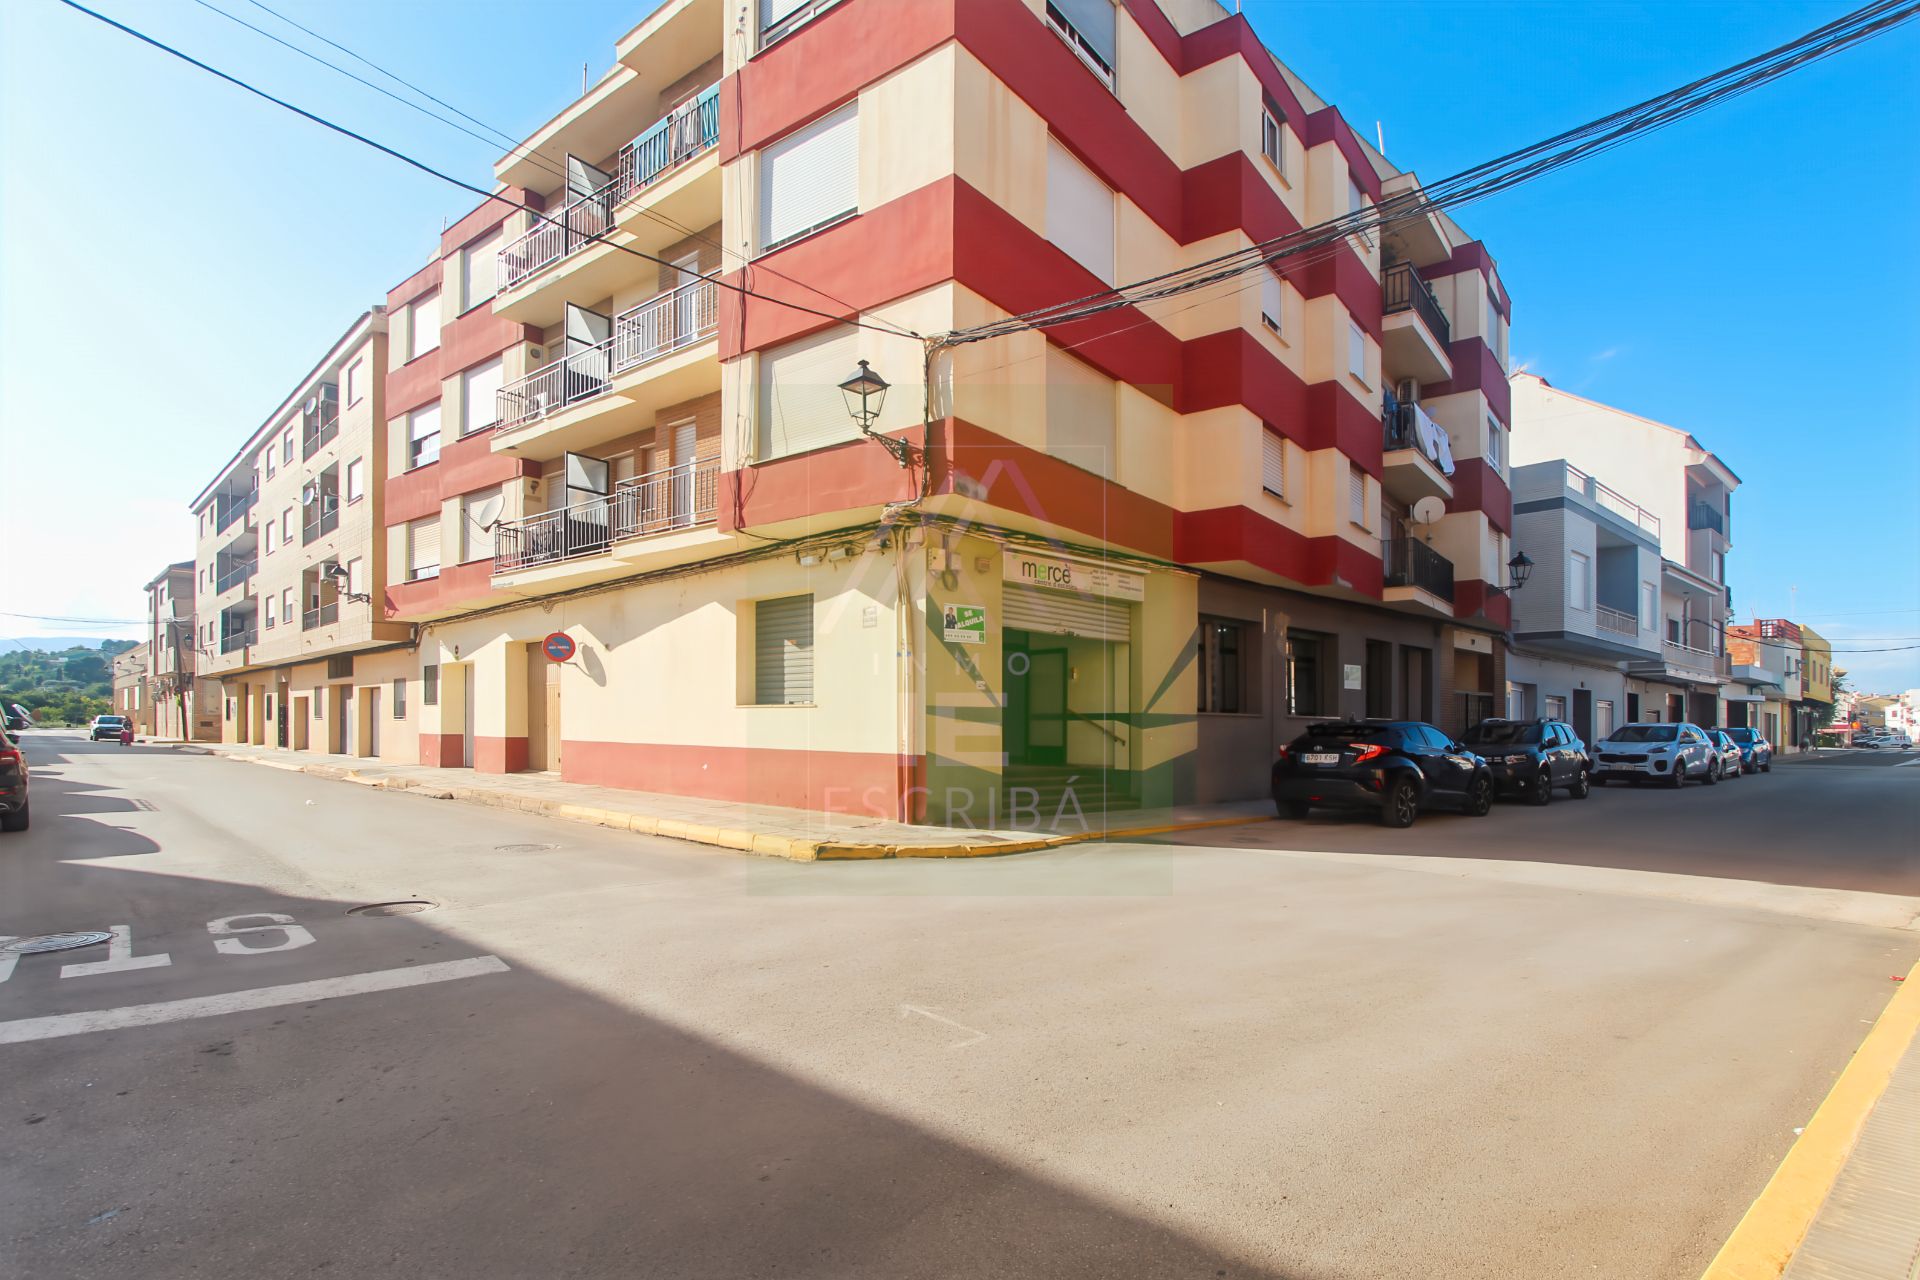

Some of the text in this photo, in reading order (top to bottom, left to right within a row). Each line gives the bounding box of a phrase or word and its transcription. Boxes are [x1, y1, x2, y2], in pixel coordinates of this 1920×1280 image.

[1022, 560, 1072, 584] mercè
[963, 609, 973, 618] SE
[957, 616, 984, 629] ALQUILA
